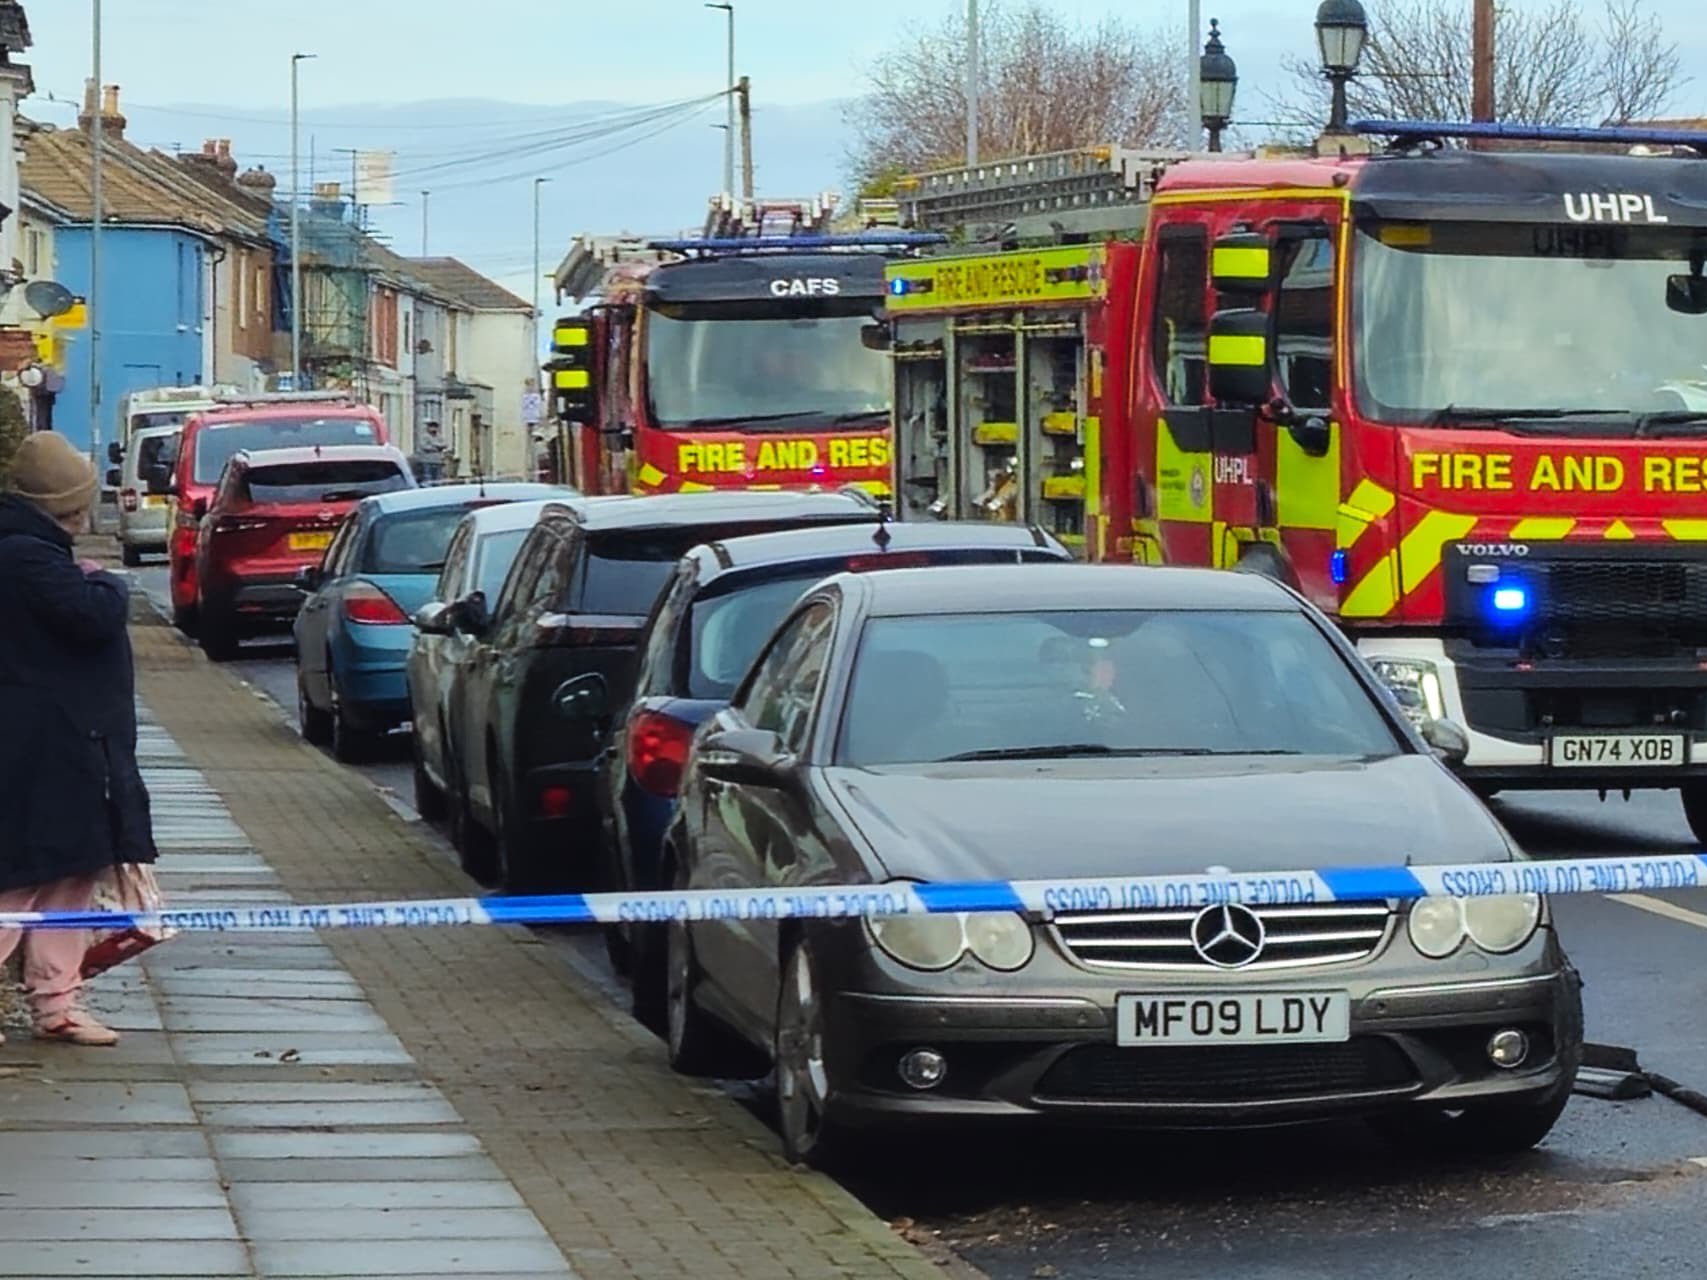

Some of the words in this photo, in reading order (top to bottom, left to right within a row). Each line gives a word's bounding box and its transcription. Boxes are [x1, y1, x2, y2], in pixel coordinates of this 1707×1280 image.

[1562, 193, 1668, 223] UHPL
[770, 278, 840, 296] CAFS
[937, 266, 962, 300] FIRE
[993, 260, 1041, 297] RESCUE
[678, 442, 745, 473] FIRE
[756, 440, 818, 469] AND
[829, 438, 889, 467] RES
[1214, 455, 1253, 485] UHPL
[1412, 453, 1514, 489] FIRE
[1530, 455, 1625, 491] AND
[1455, 544, 1529, 556] VOLVO
[1563, 739, 1622, 761] GN74
[1629, 738, 1673, 761] XOB
[1588, 865, 1628, 892] LINE
[1635, 861, 1698, 890] POLICE
[1134, 999, 1241, 1038] MF09
[1255, 997, 1331, 1035] LDY
